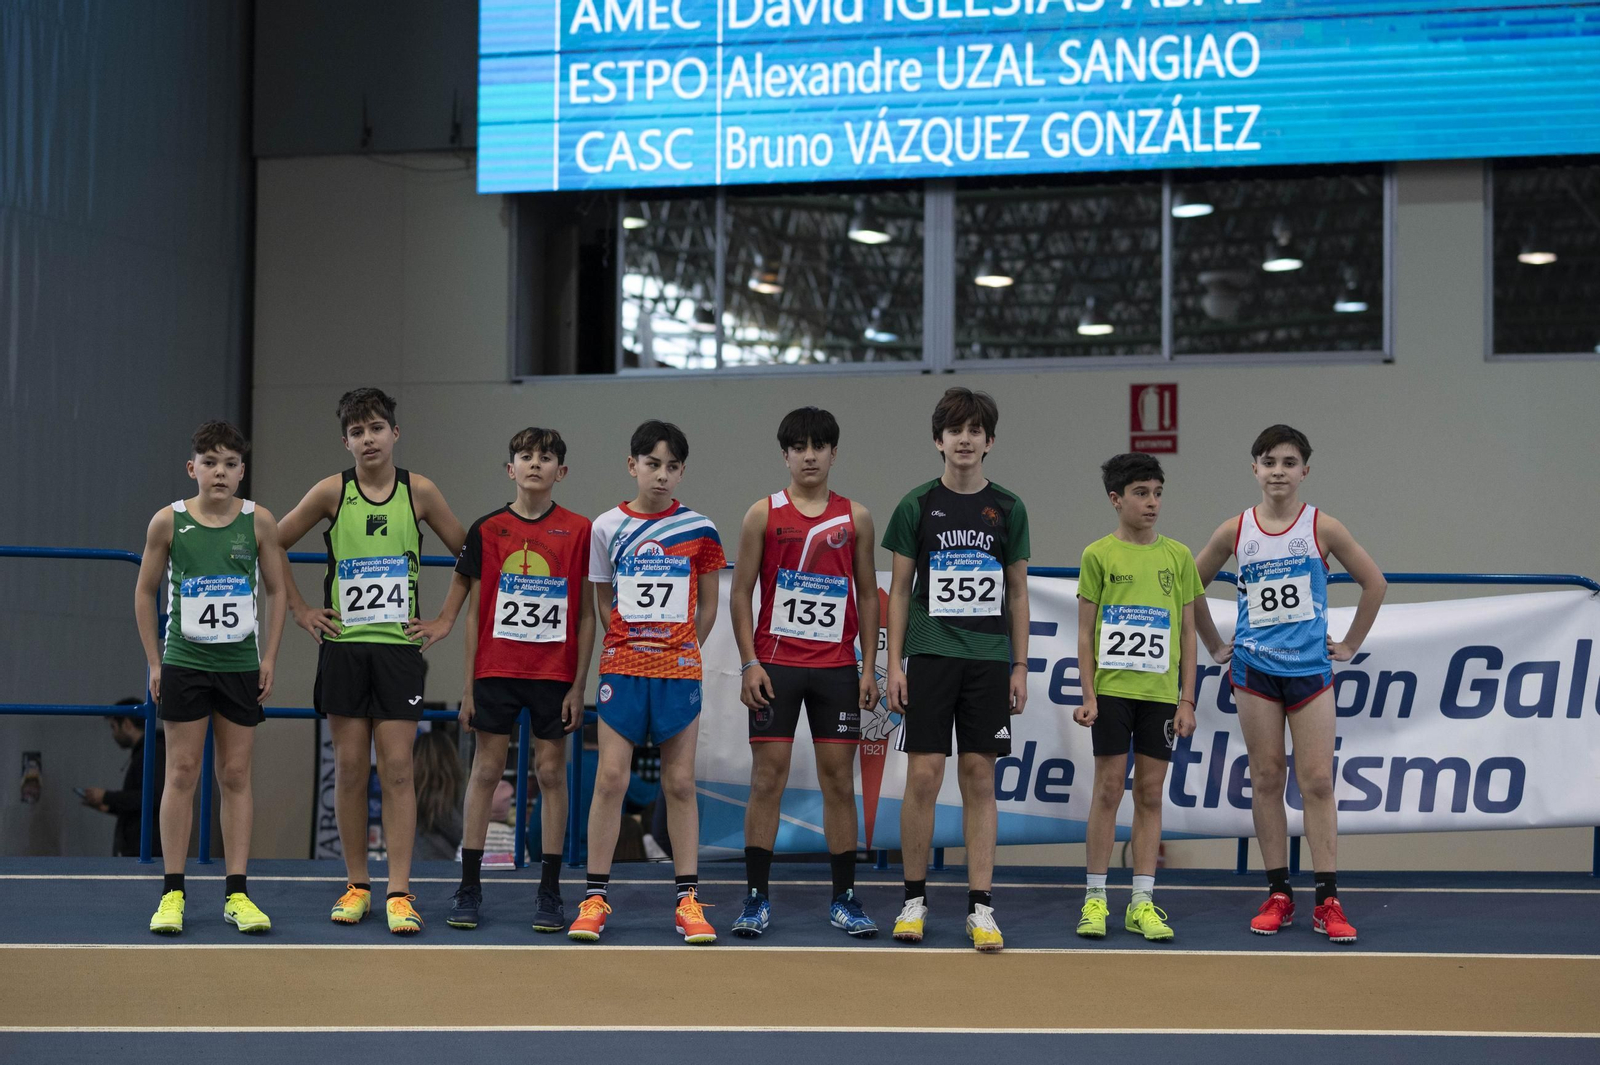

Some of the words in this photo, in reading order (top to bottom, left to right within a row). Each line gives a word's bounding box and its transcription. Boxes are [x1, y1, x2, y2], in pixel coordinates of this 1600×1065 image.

[571, 0, 701, 34] AMEC
[728, 0, 863, 29] David
[569, 56, 709, 106] ESTPO
[724, 46, 923, 100] Alexandre
[937, 43, 1046, 90] UZAL
[1058, 31, 1260, 87] SANGIAO
[575, 127, 695, 174] CASC
[726, 126, 831, 171] Bruno
[844, 110, 1030, 168] VÁZQUEZ
[1041, 96, 1261, 159] GONZÁLEZ
[936, 529, 994, 550] XUNCAS
[383, 558, 404, 566] Galega
[664, 558, 686, 566] Galega
[1264, 567, 1291, 576] Atletismo
[1284, 558, 1306, 566] Galega
[227, 576, 246, 585] Galega
[514, 576, 543, 584] Federación
[544, 579, 565, 587] Galega
[794, 573, 824, 583] Federación
[824, 578, 845, 586] Galega
[801, 581, 830, 590] Atletismo
[937, 577, 996, 602] 352
[346, 584, 404, 612] 224
[637, 583, 673, 607] 37
[1261, 584, 1300, 612] 88
[199, 603, 239, 628] 45
[501, 601, 561, 629] 234
[783, 598, 837, 627] 133
[1148, 609, 1168, 617] Galega
[1107, 631, 1164, 659] 225
[1439, 638, 1600, 719] Gal
[863, 744, 884, 756] 1921
[994, 739, 1075, 803] de
